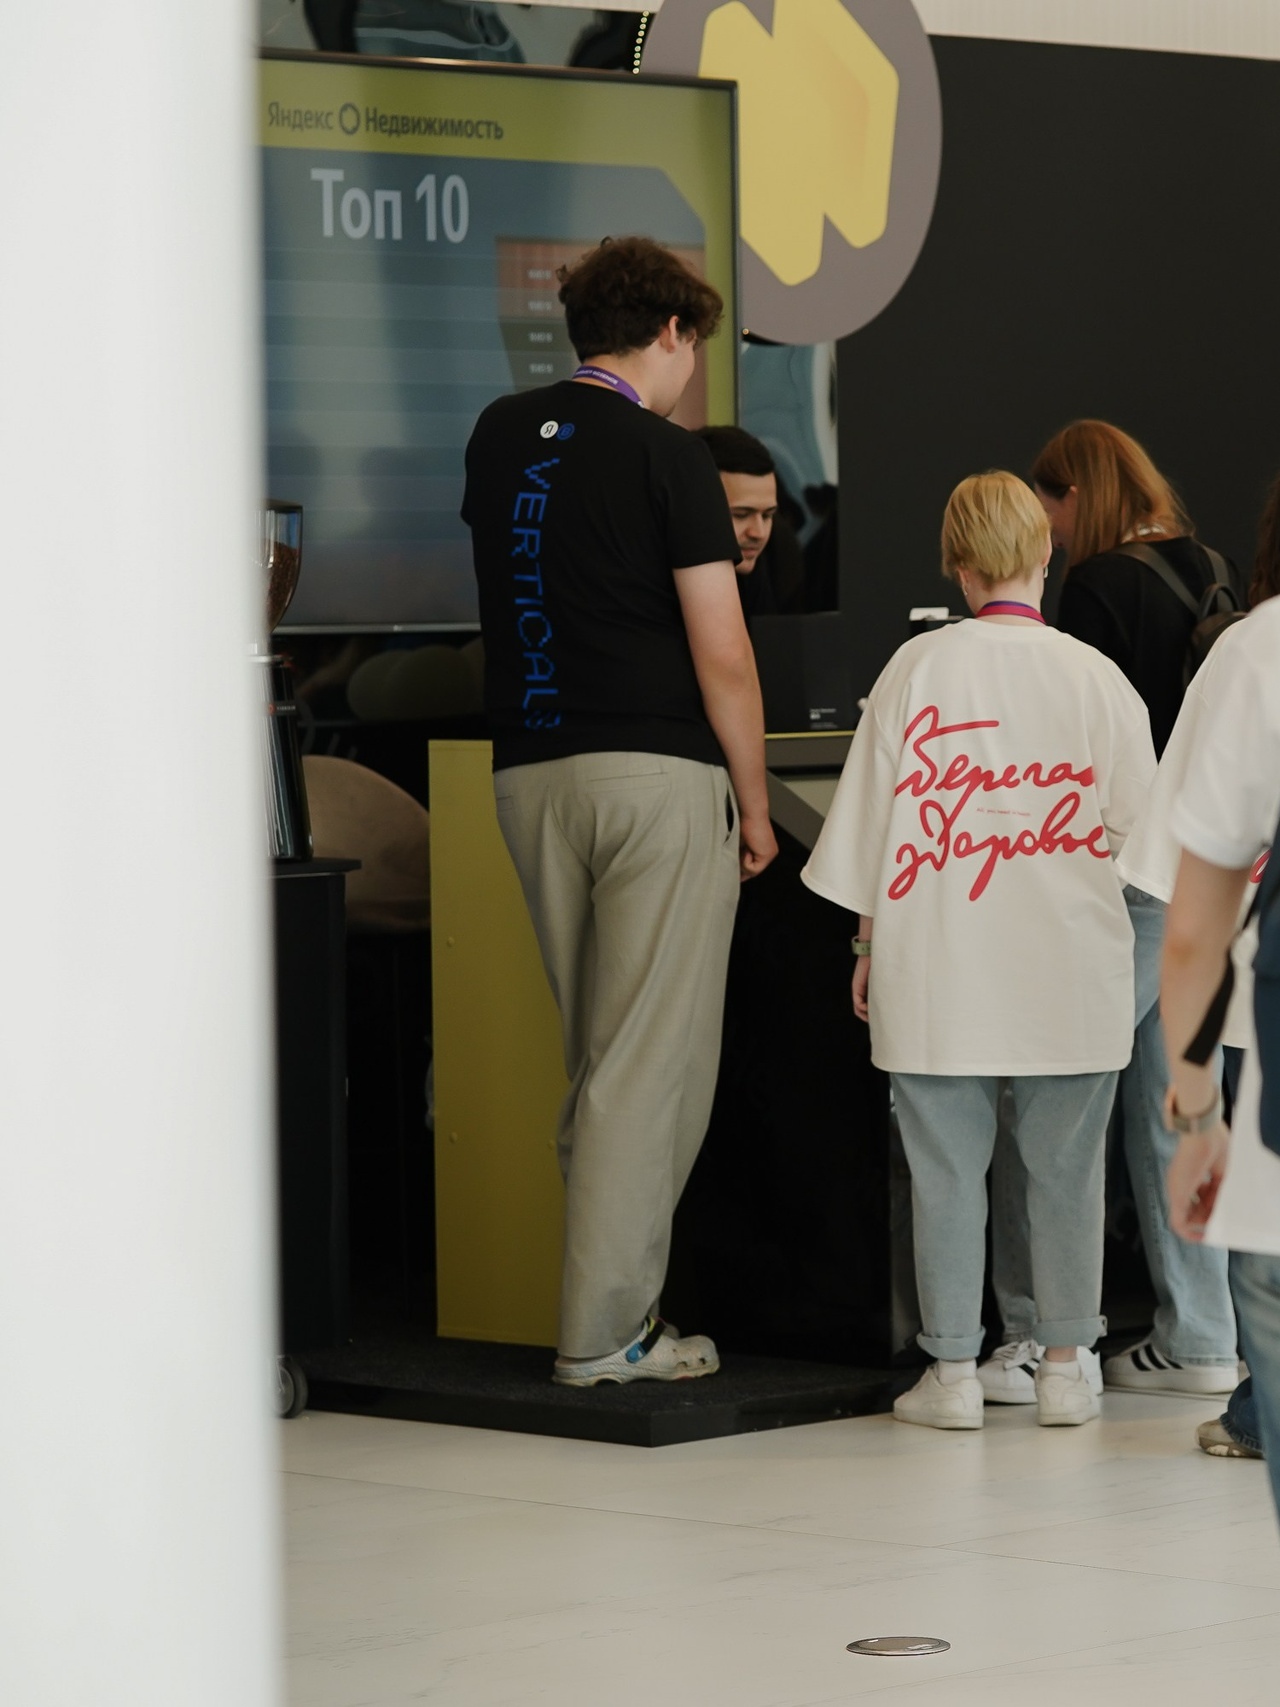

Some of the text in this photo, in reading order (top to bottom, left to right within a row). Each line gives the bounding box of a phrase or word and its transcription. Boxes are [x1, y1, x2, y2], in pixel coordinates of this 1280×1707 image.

[268, 102, 504, 140] Яндекс Недвижимость
[310, 168, 469, 243] Топ 10
